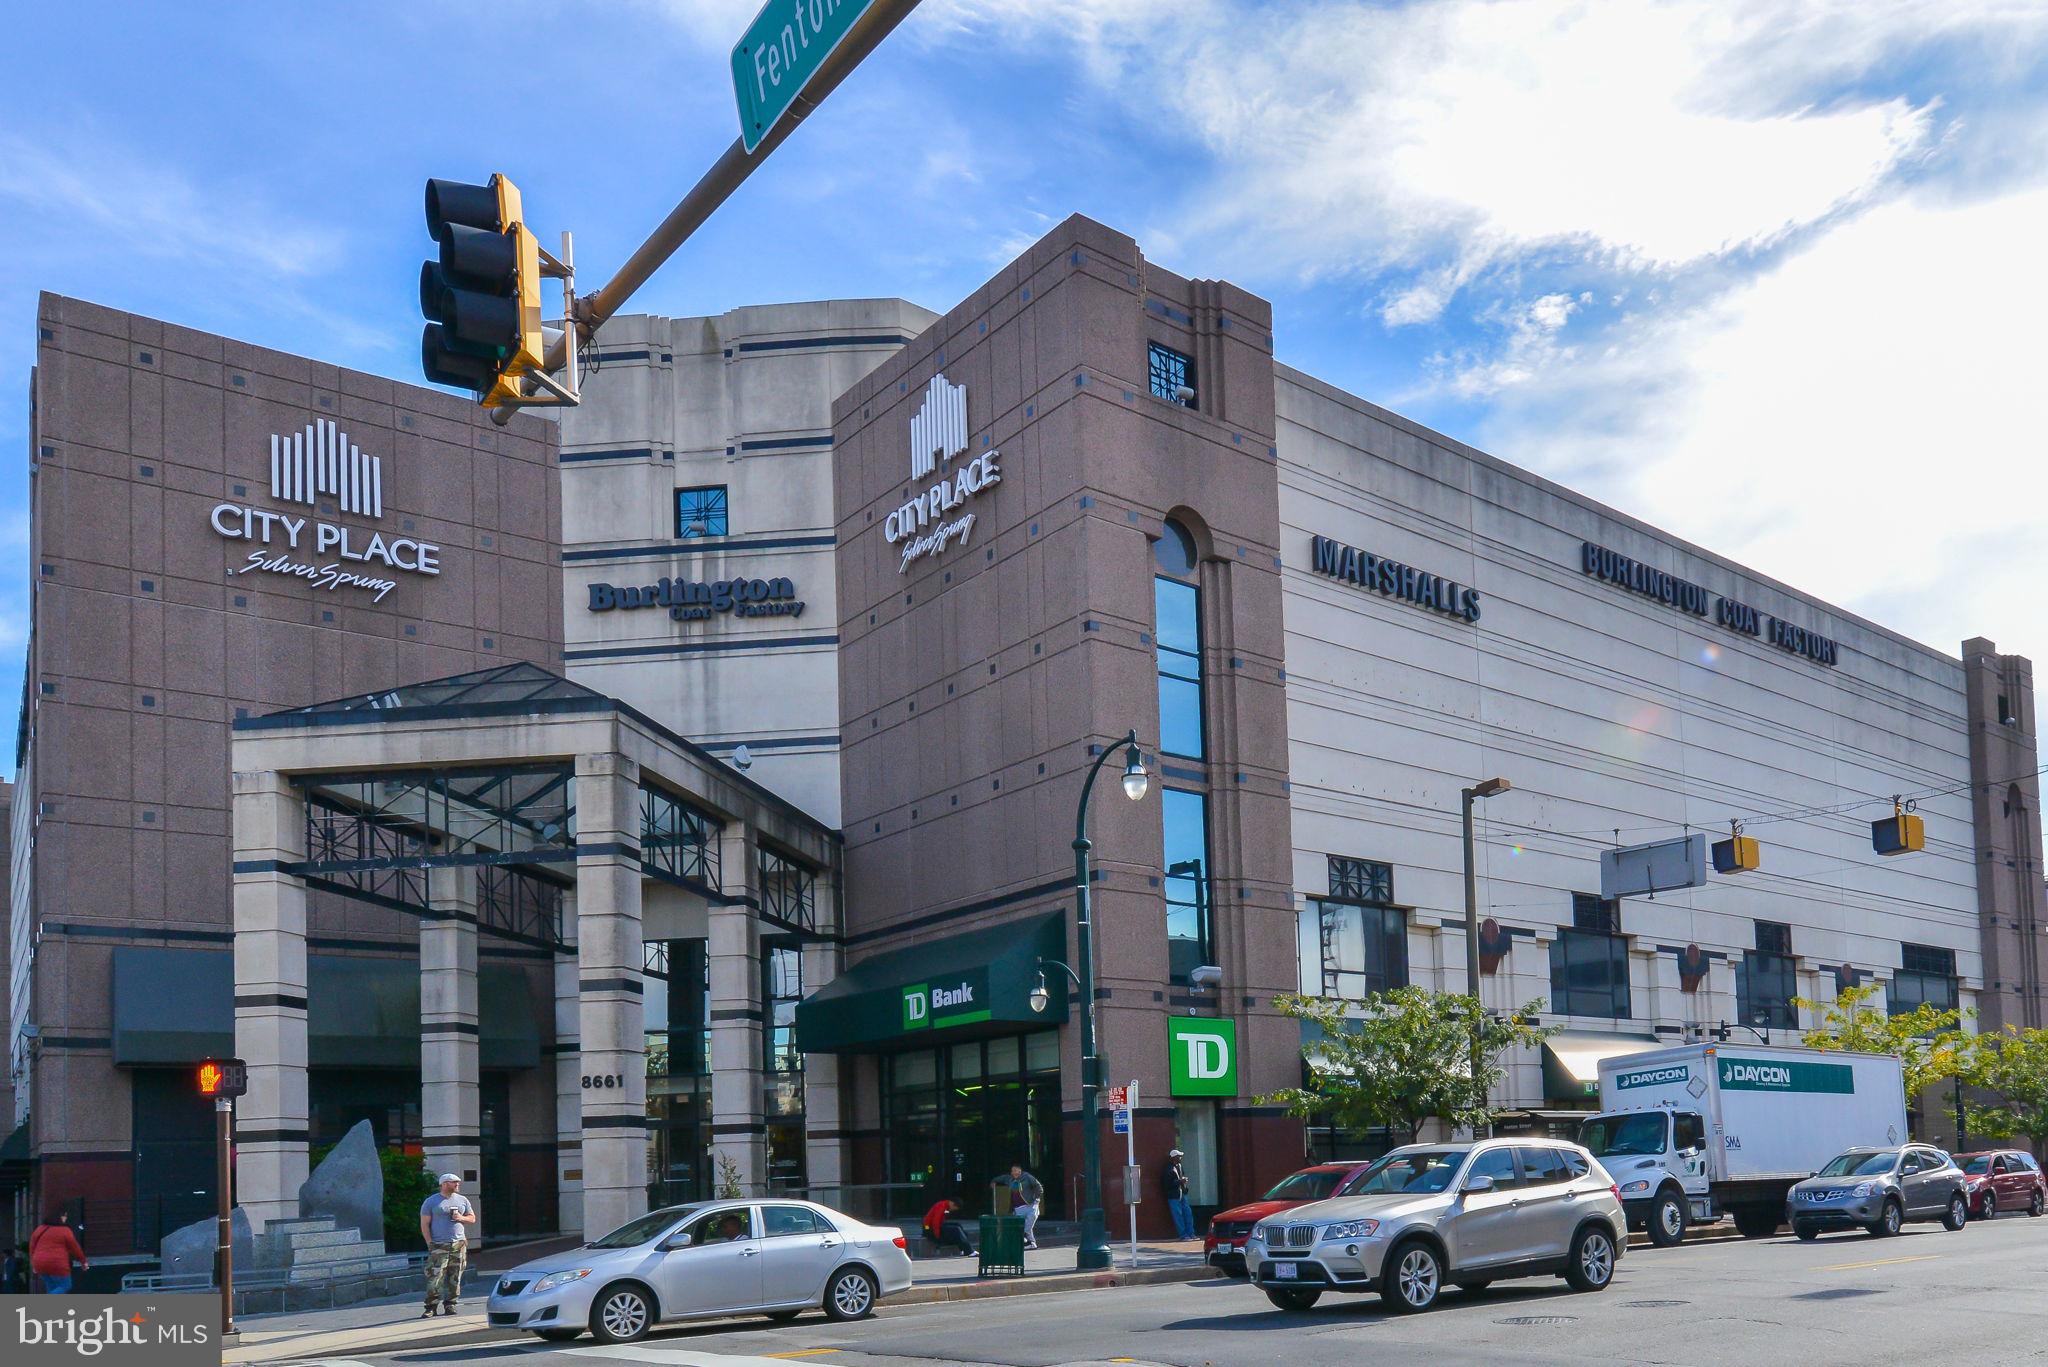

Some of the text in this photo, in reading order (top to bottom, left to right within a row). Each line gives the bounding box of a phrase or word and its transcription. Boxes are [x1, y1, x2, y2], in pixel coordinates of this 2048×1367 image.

[754, 0, 841, 103] Fento
[885, 449, 1001, 543] CITY PLACE
[210, 504, 440, 575] CITY PLACE
[899, 513, 977, 574] Silver Spring
[239, 550, 396, 603] Silver Spring
[588, 576, 795, 612] Burlington
[1312, 534, 1481, 622] MARSHALLS
[669, 601, 805, 621] Coat Factory
[1582, 541, 1840, 666] BURLINGTON COAT FACTORY
[905, 982, 974, 1020] TD Bank
[1176, 1033, 1229, 1078] TD
[1631, 1068, 1686, 1084] DAYCON
[1733, 1065, 1791, 1083] DAYCON
[581, 1074, 624, 1089] 8661
[1725, 1135, 1741, 1148] SMA
